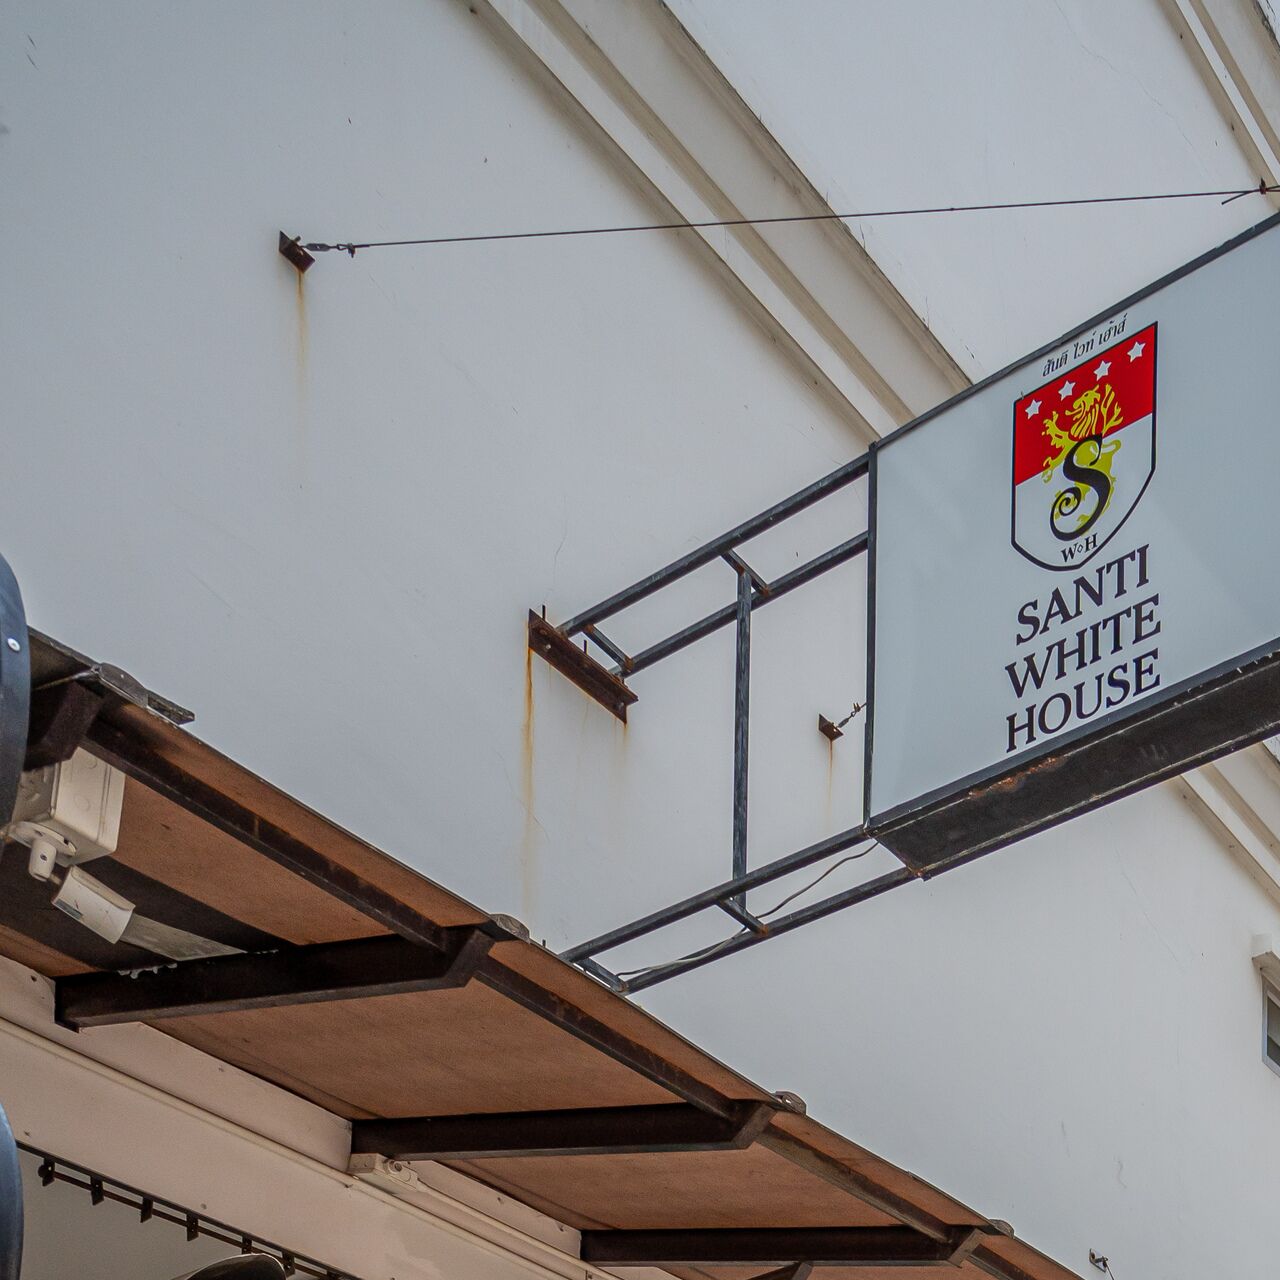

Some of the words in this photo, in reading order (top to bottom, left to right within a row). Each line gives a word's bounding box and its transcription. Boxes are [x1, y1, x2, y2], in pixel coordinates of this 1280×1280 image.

[1004, 593, 1161, 699] WHITE
[1016, 543, 1150, 646] SANTI
[1006, 647, 1161, 754] HOUSE
